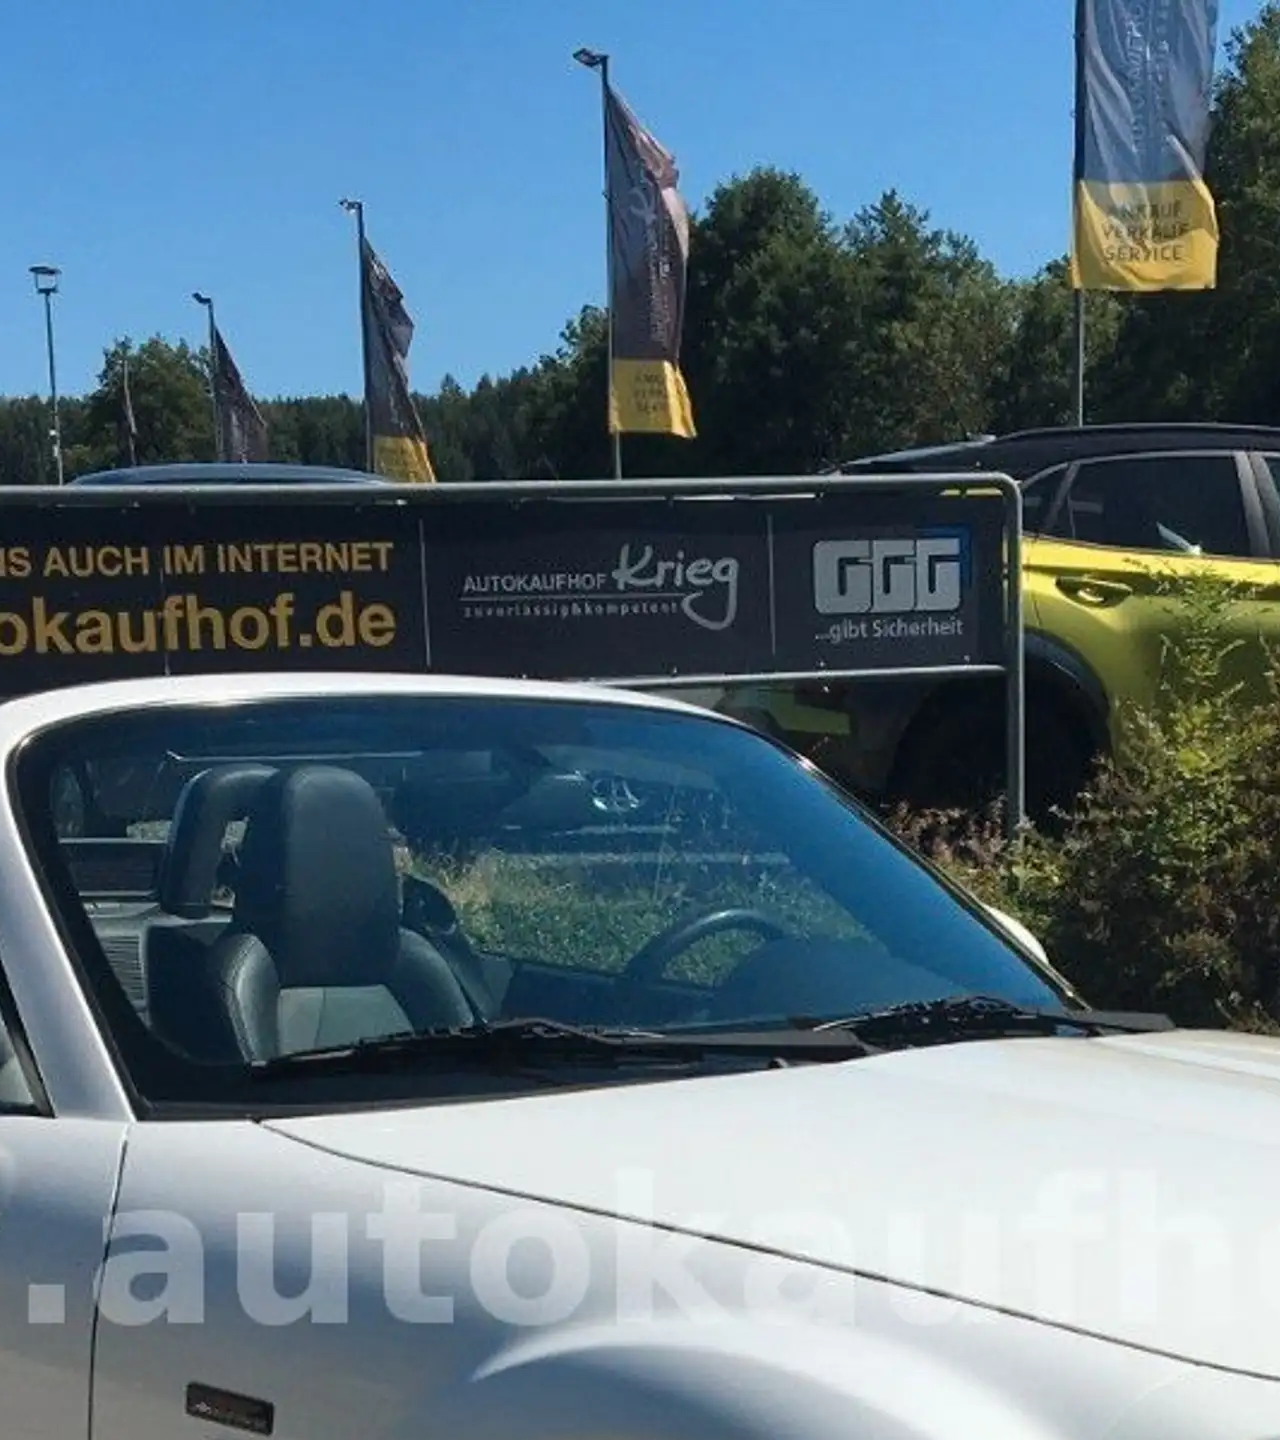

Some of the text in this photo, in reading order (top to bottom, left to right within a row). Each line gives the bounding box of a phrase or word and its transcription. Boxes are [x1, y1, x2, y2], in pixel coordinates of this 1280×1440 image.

[43, 546, 149, 578] AUCH
[165, 544, 204, 574] IM
[219, 542, 393, 573] INTERNET
[463, 544, 739, 630] AUTOKAUFHOF Krieg
[813, 537, 961, 615] GGG
[872, 616, 965, 639] Sicherheit
